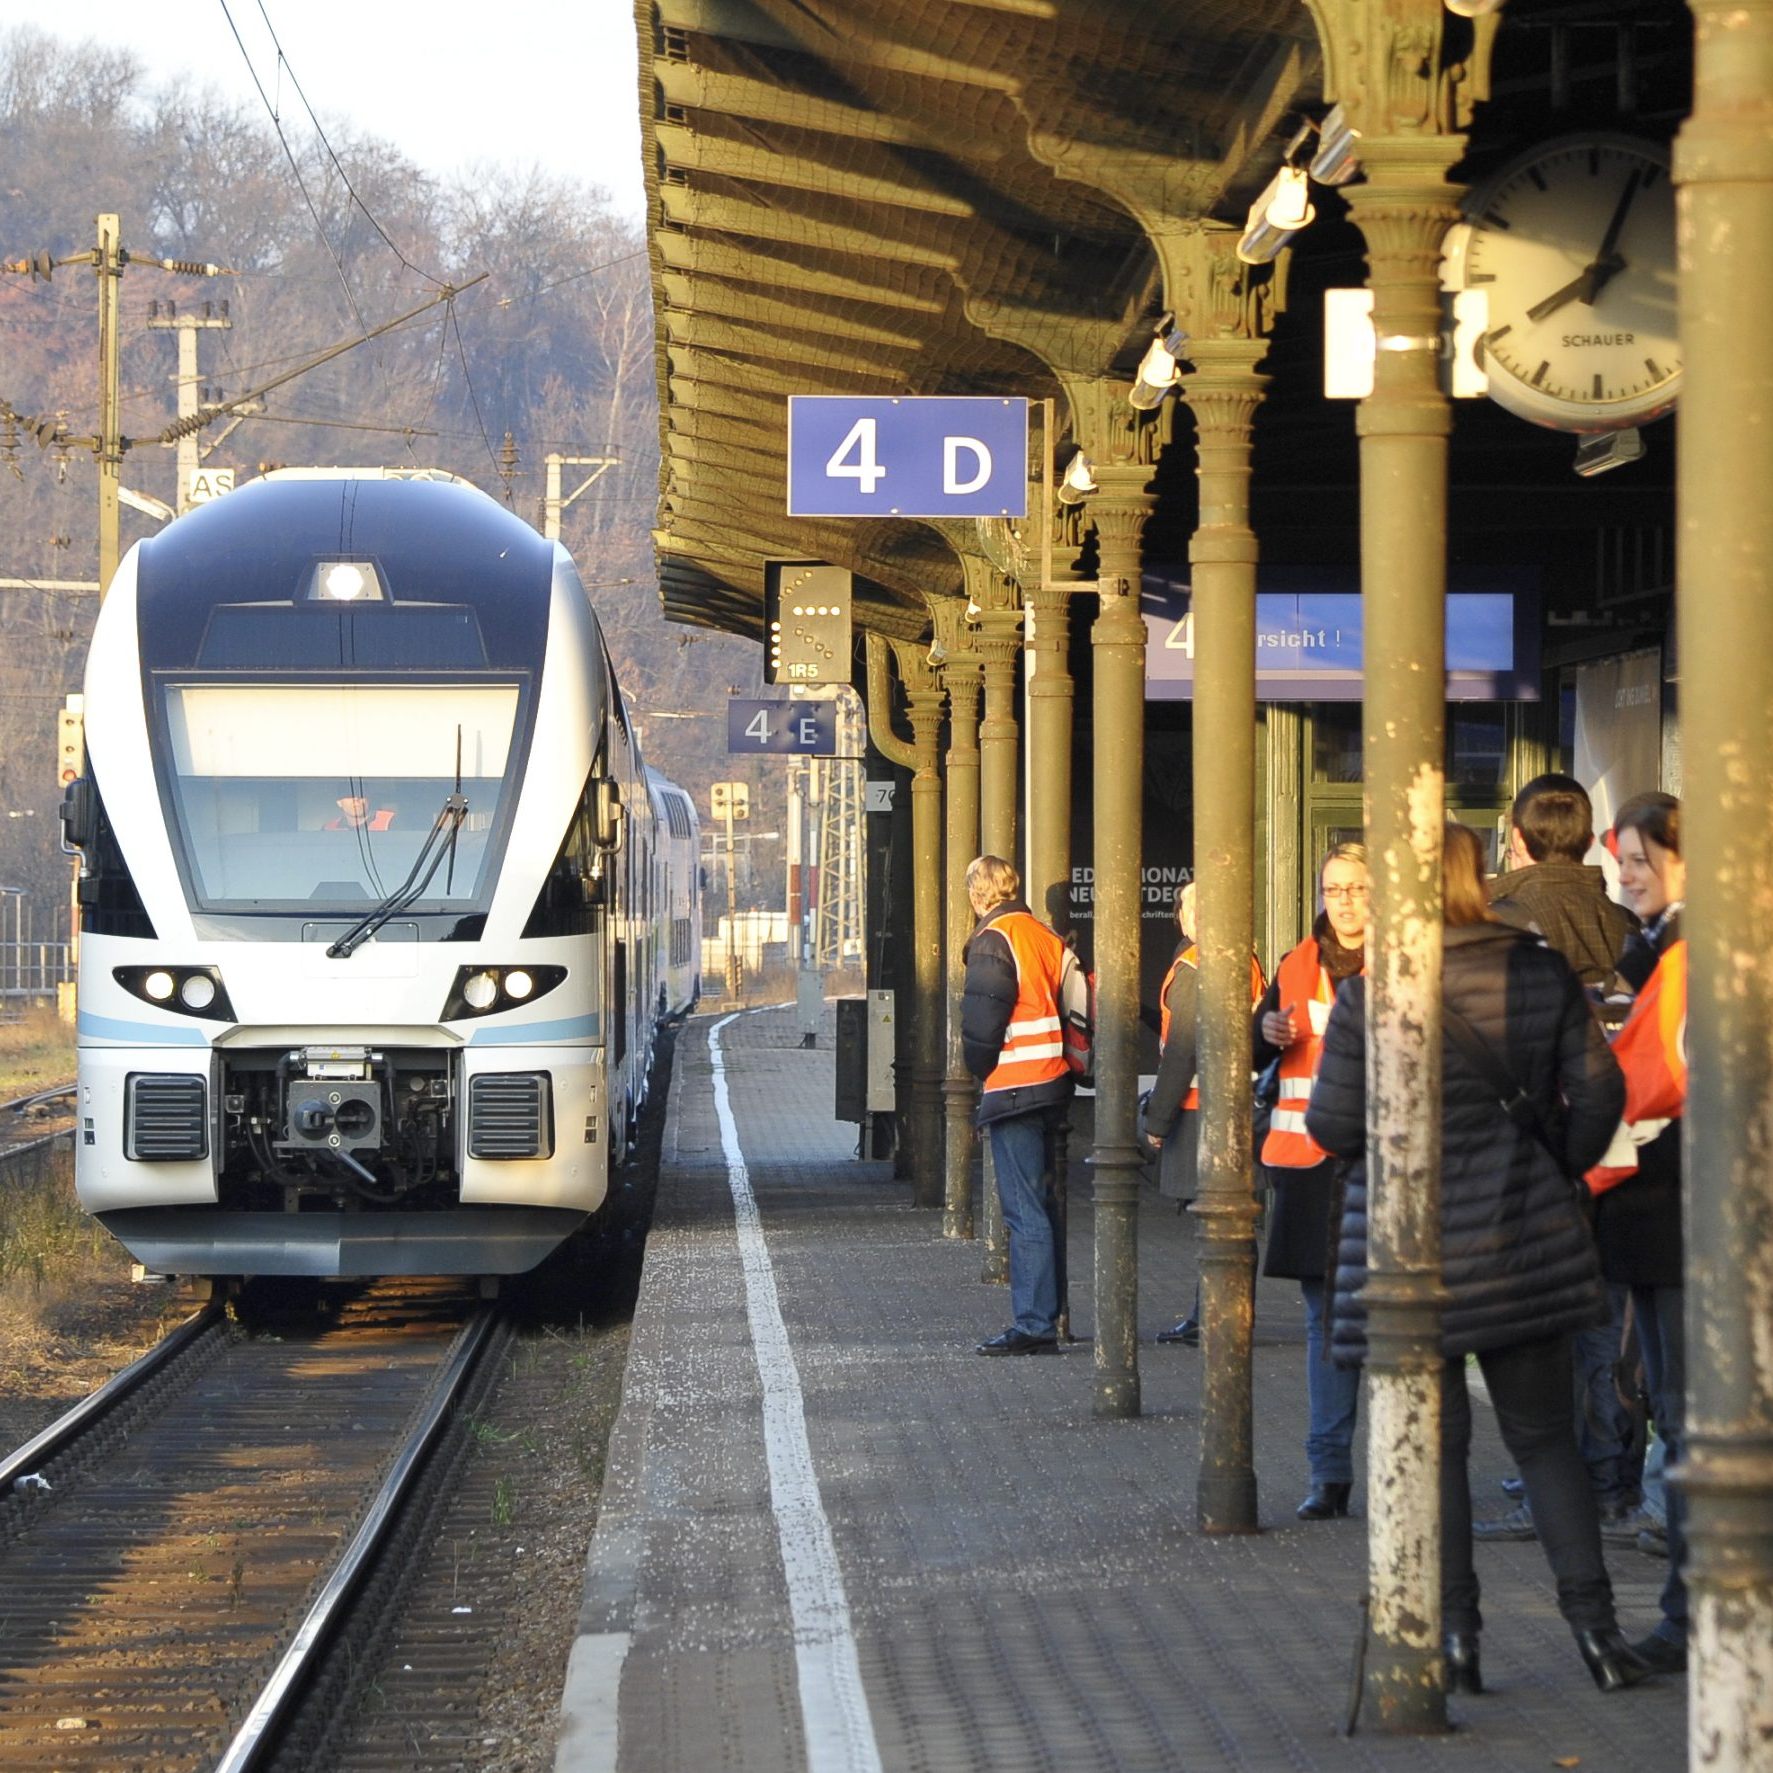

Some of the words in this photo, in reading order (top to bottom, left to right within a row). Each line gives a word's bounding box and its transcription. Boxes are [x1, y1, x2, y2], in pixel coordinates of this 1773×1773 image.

[1561, 333, 1635, 348] SCHAUER
[826, 418, 886, 494] 4
[943, 436, 992, 495] D
[193, 475, 231, 497] AS
[1165, 612, 1195, 659] 4
[1257, 630, 1326, 648] rsicht
[788, 663, 819, 678] 1R5
[745, 710, 772, 744] 4
[800, 718, 816, 744] E
